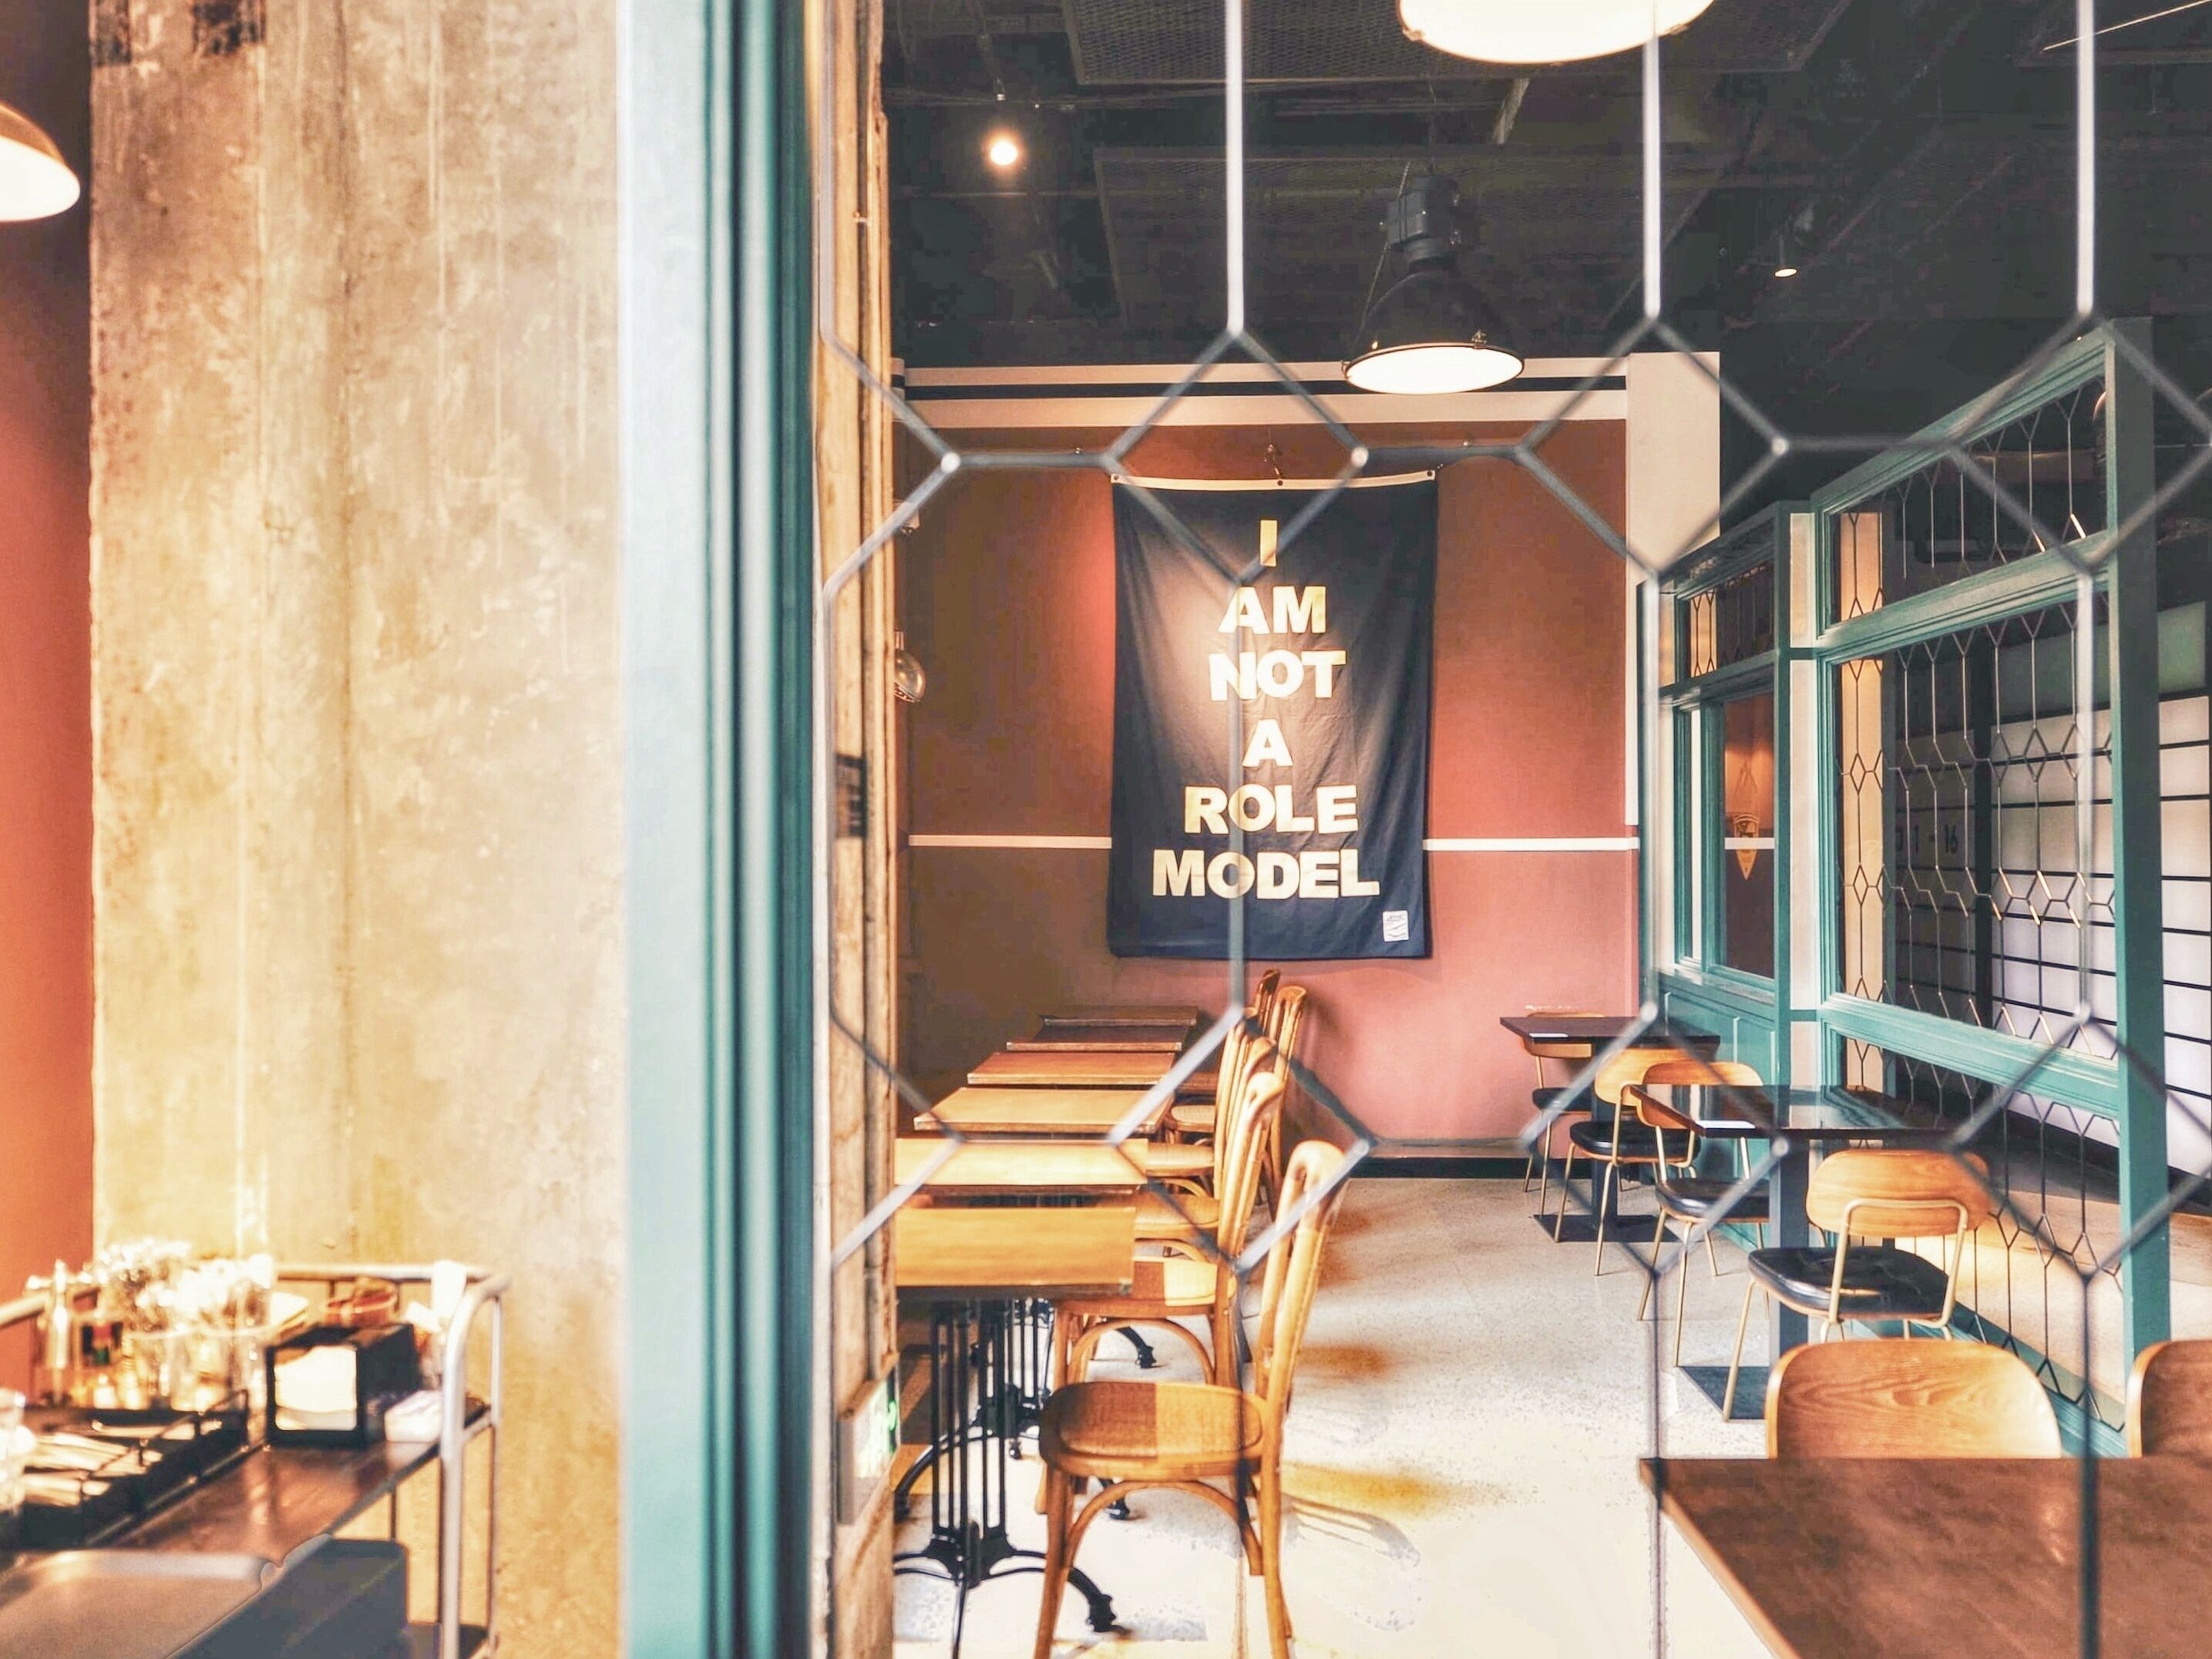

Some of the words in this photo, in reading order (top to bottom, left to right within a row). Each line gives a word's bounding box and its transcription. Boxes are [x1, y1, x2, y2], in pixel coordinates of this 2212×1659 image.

[1260, 520, 1278, 566] I
[1219, 586, 1326, 634] AM
[1209, 649, 1346, 701] NOT
[1242, 718, 1294, 767] A
[1185, 784, 1359, 835] ROLE
[1153, 848, 1380, 899] MODEL
